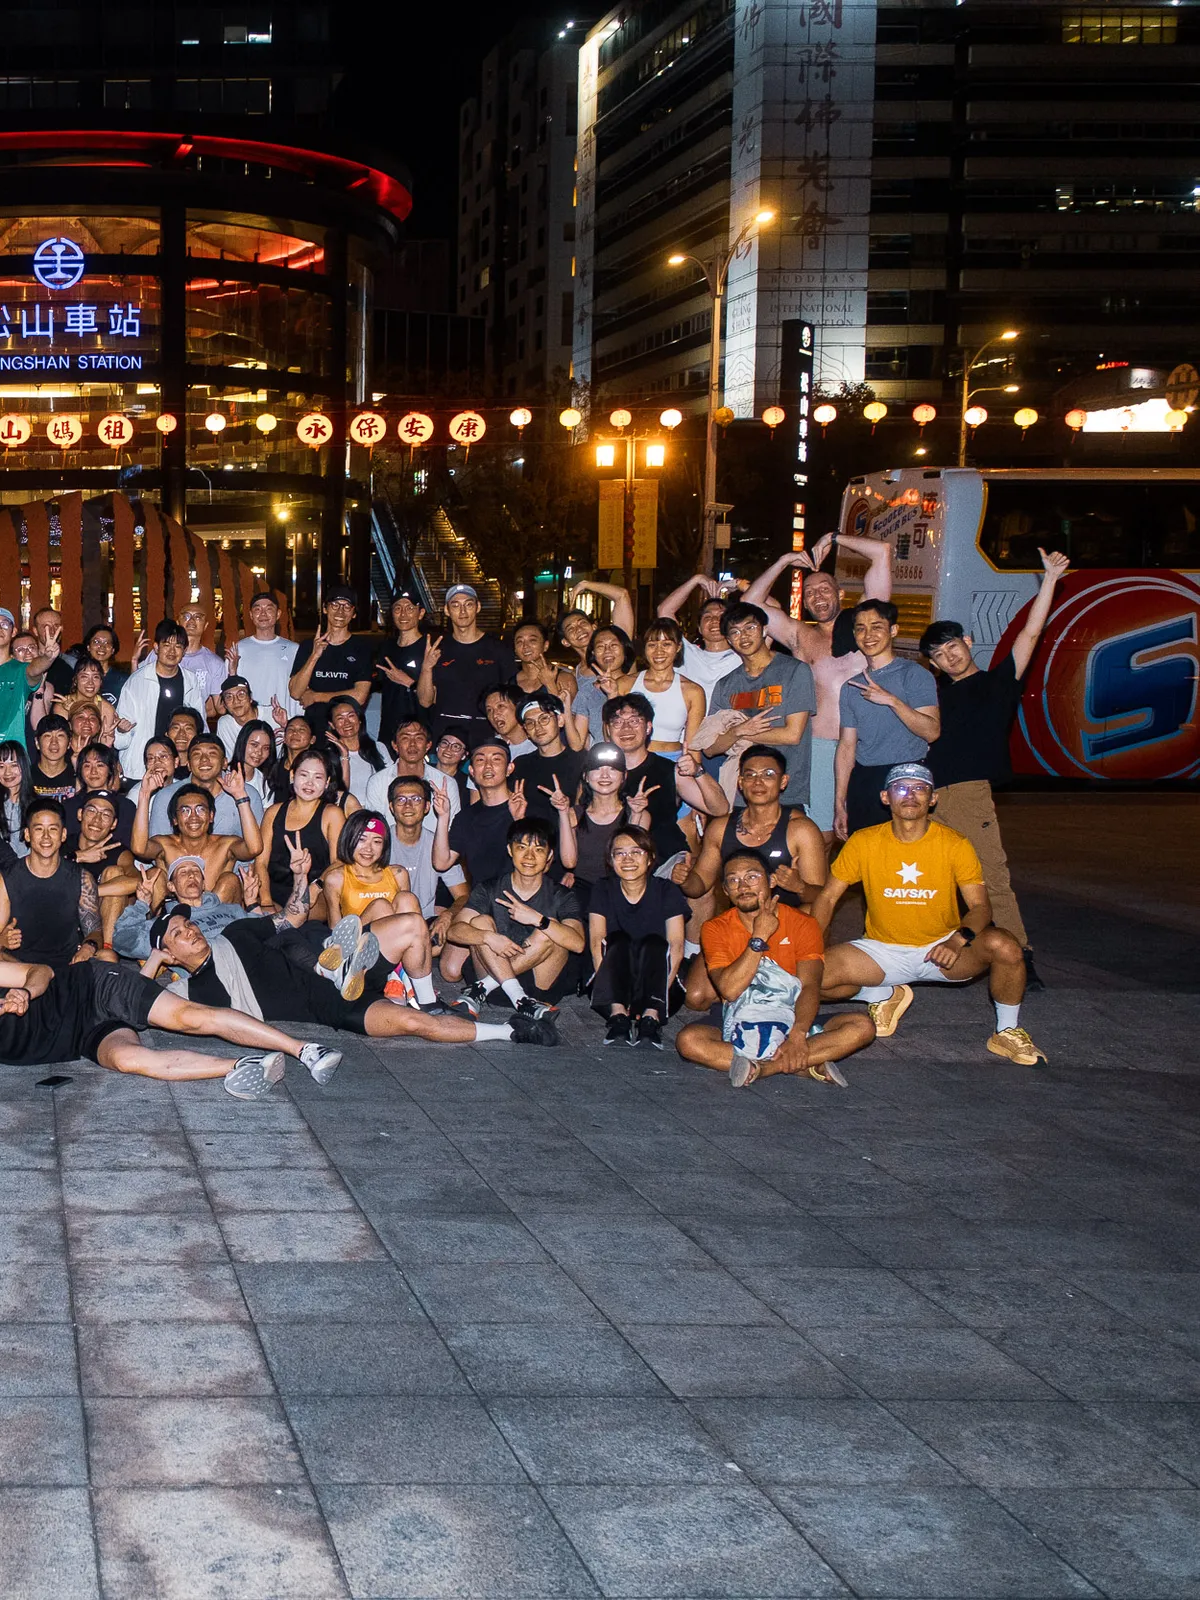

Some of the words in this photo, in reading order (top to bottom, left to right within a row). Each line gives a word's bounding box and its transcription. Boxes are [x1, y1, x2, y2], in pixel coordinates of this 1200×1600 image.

[770, 274, 855, 284] BUDDHA'S
[770, 304, 853, 313] INTERNATIONAL
[77, 355, 142, 369] STATION
[315, 670, 349, 680] BLKWTR
[1080, 611, 1199, 763] S
[358, 891, 391, 900] SAYSKY
[882, 887, 938, 899] SAYSKY
